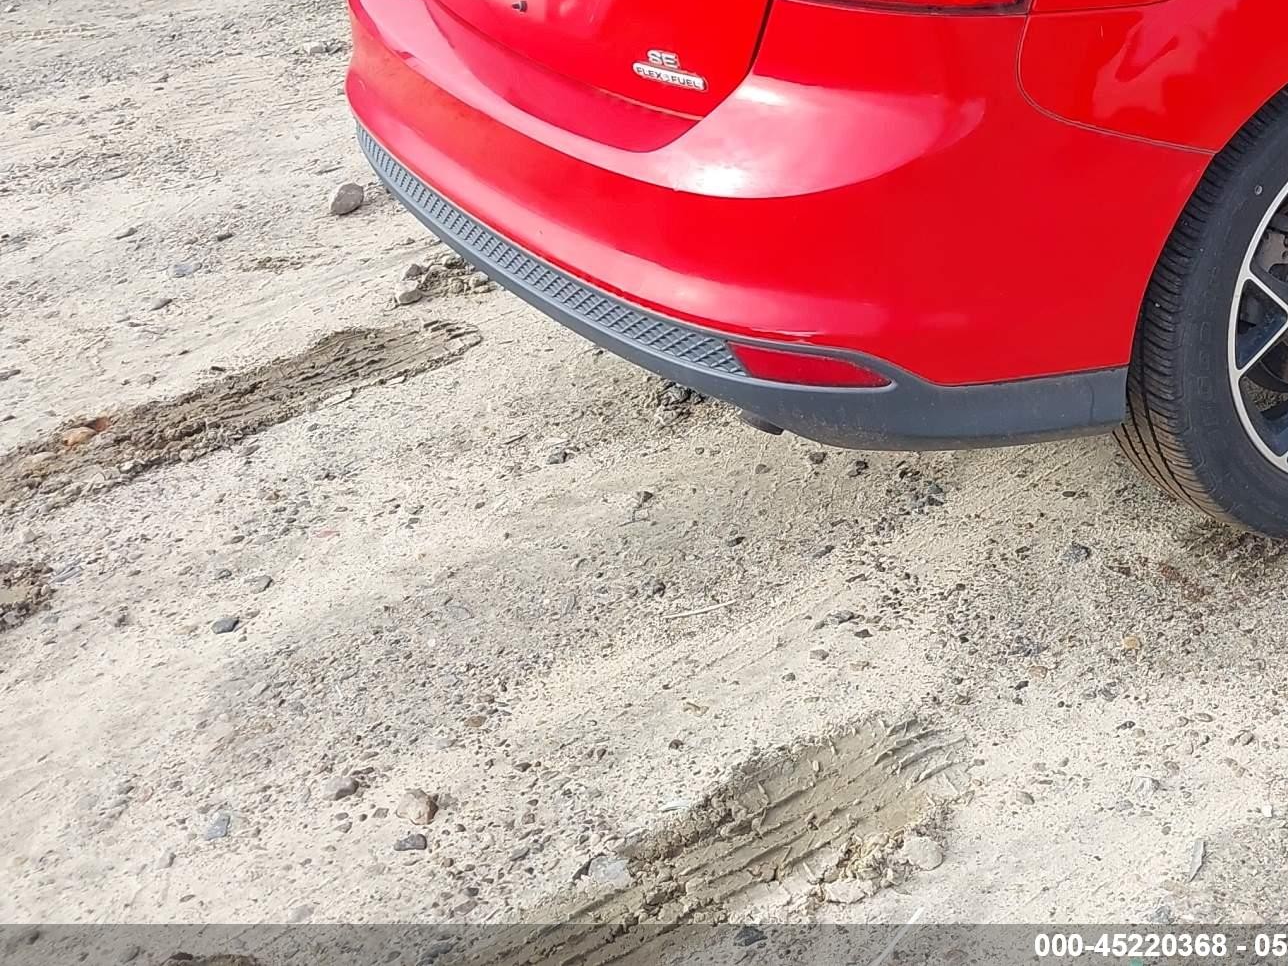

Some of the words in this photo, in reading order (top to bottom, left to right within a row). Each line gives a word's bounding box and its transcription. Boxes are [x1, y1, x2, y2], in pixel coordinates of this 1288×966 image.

[647, 49, 681, 69] SE
[636, 66, 663, 81] FLEX
[670, 75, 701, 88] FUEL
